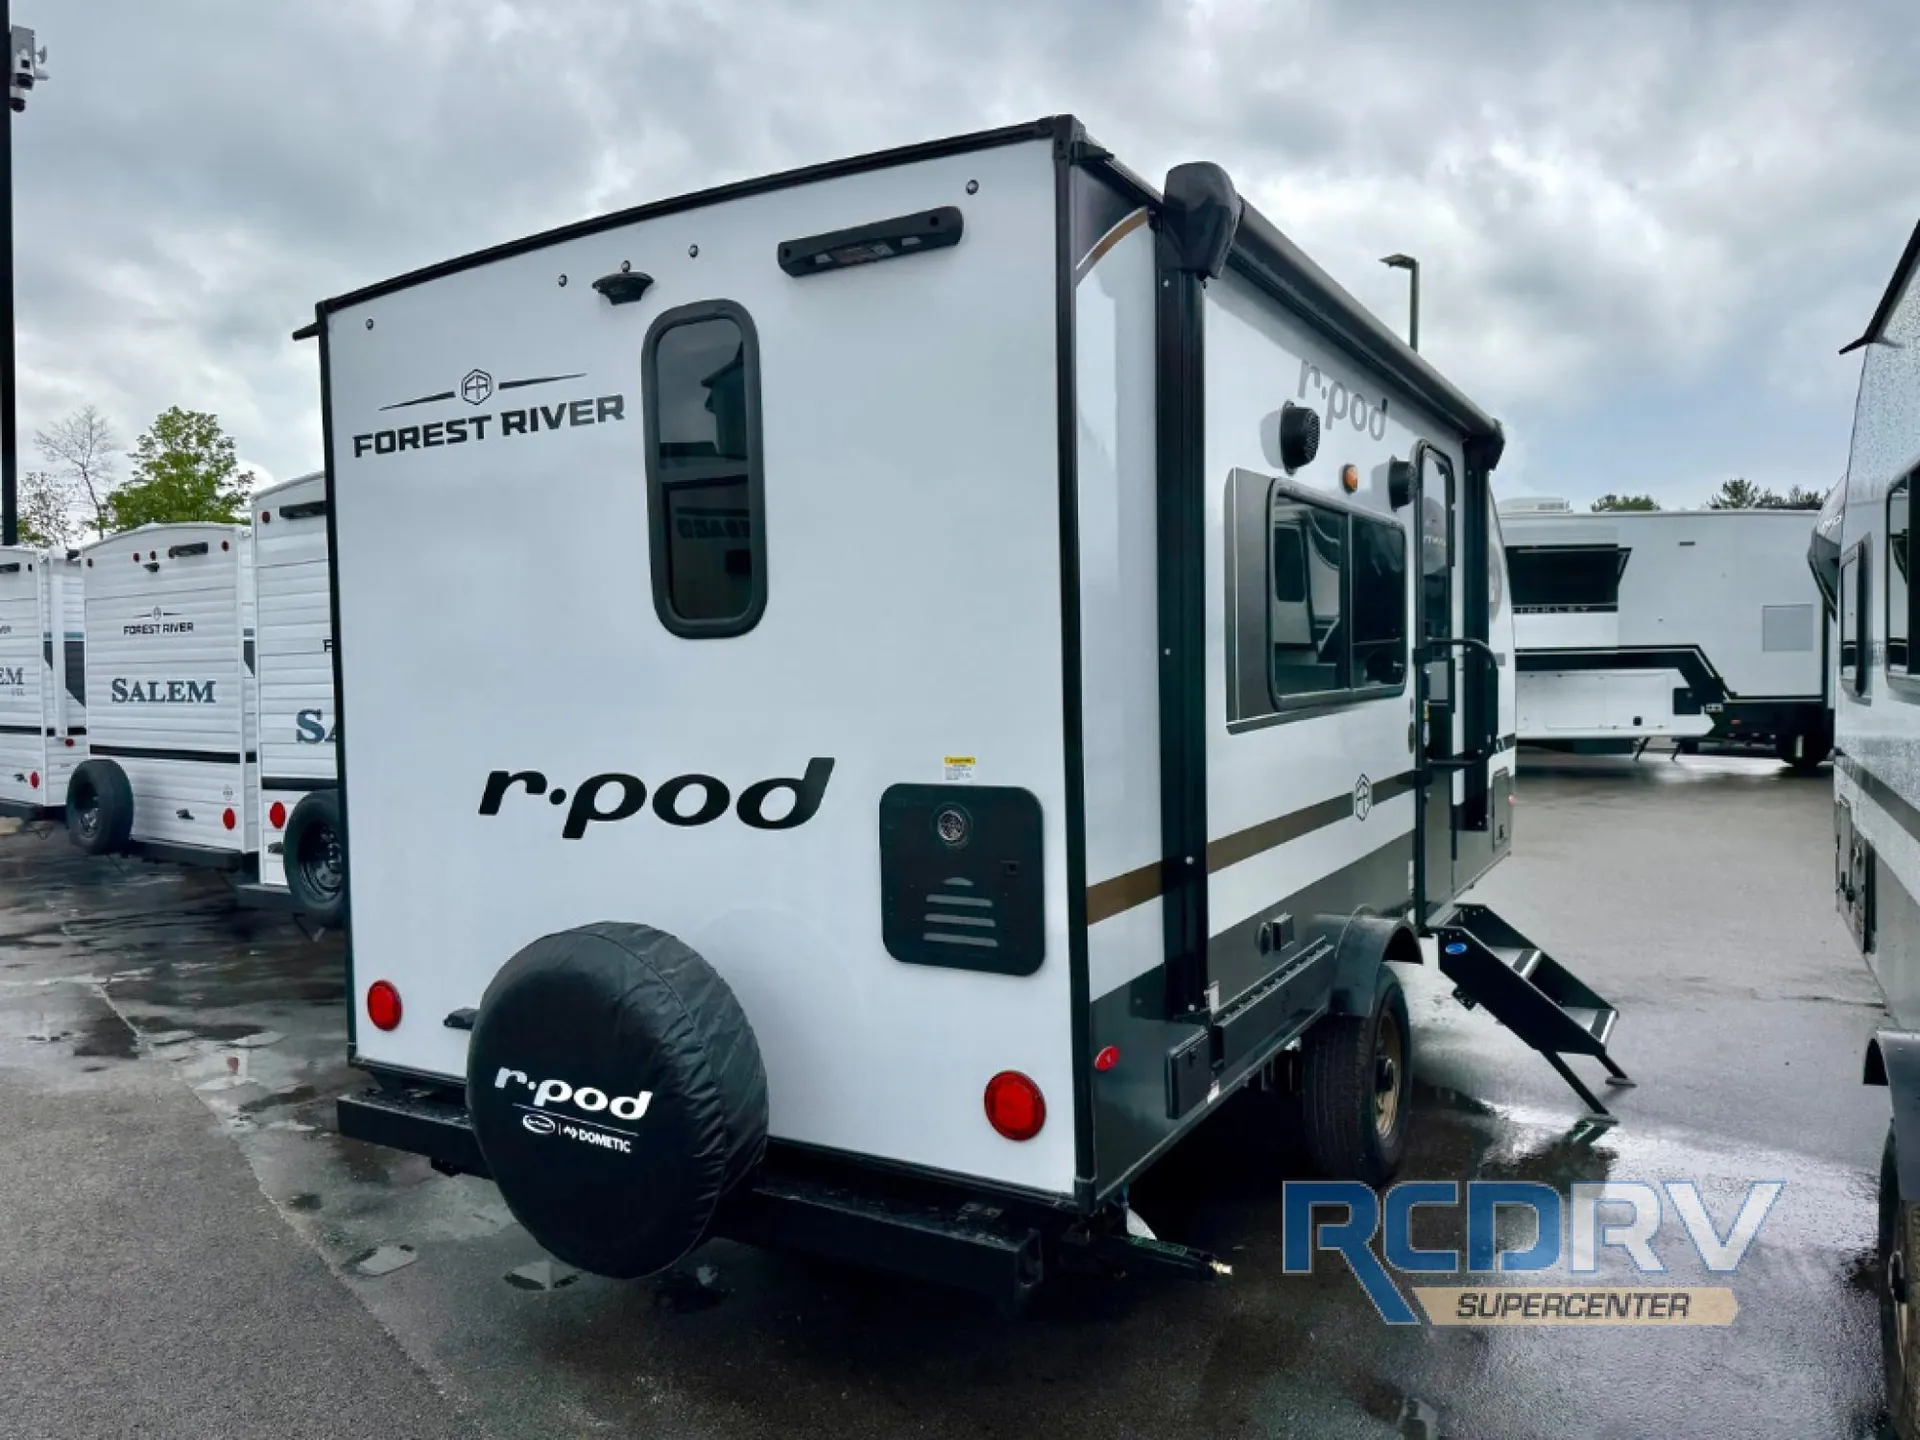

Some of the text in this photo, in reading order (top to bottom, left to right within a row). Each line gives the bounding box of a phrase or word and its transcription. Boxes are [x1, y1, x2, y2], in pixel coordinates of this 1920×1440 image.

[352, 394, 625, 458] FOREST RIVER
[123, 622, 194, 635] FOREST RIVER
[111, 678, 217, 703] SALEM
[579, 1129, 632, 1153] DOMETIC
